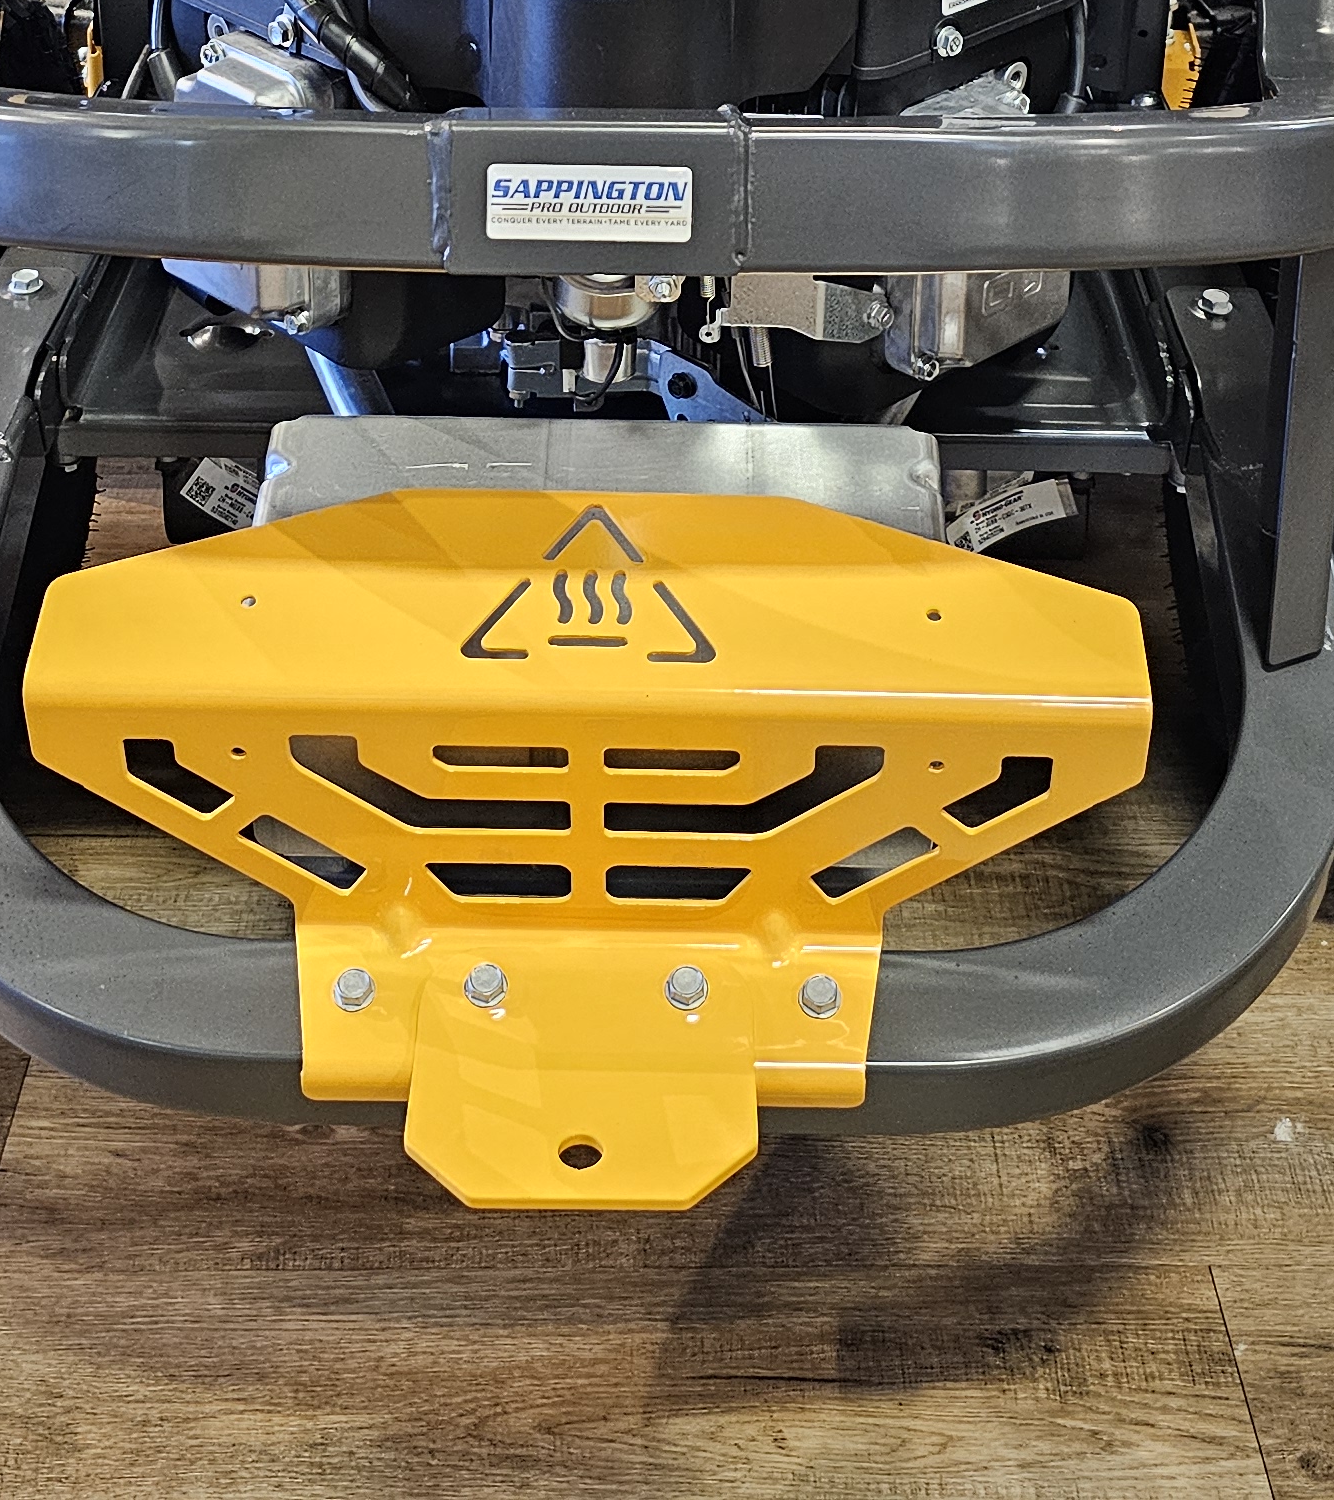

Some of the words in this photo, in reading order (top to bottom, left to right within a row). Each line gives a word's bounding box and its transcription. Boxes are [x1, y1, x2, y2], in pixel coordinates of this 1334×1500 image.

[491, 178, 688, 202] SAPPINGTON
[529, 202, 563, 213] PRO
[568, 202, 643, 214] OUTDOOR
[491, 216, 533, 224] CONQUER
[634, 219, 662, 227] EVERY
